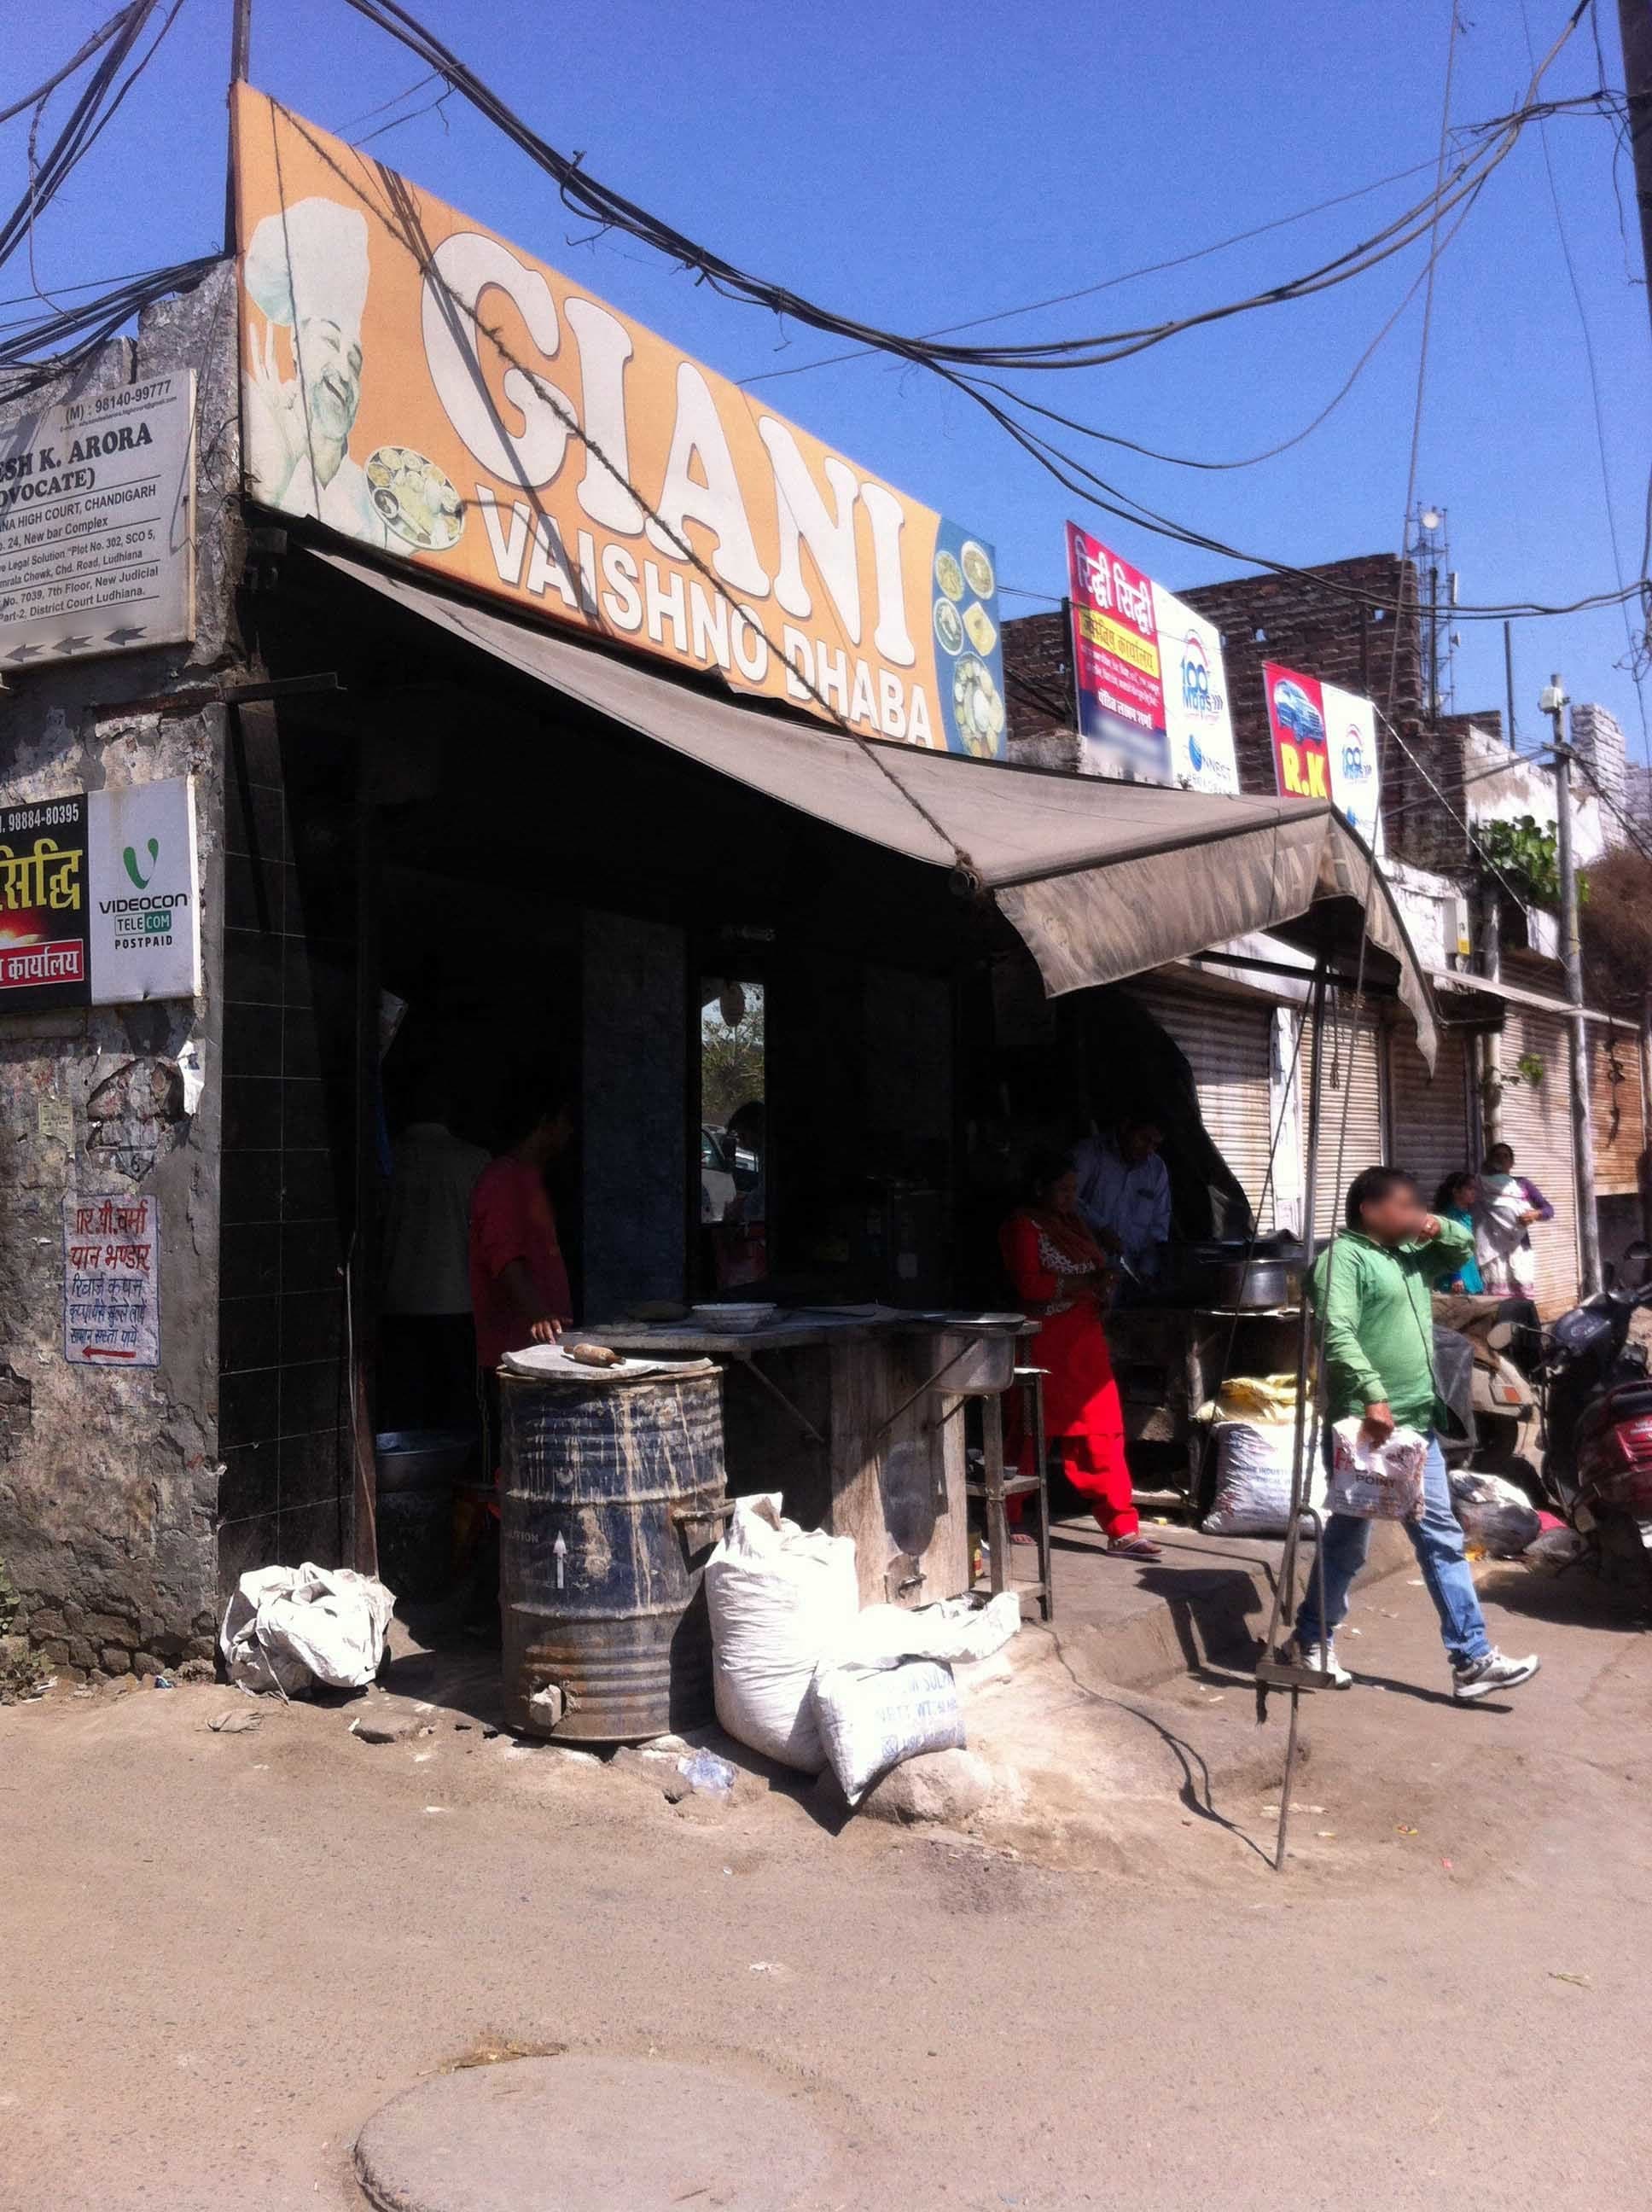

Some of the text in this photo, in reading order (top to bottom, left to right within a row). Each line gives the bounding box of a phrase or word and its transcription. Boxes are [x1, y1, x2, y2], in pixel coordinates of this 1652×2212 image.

[66, 405, 84, 425] (M)
[96, 379, 172, 413] 98140-99777
[39, 447, 61, 472] K.
[68, 422, 153, 464] ARORA
[422, 232, 915, 665] GIANI
[18, 511, 43, 528] HIGH
[45, 502, 83, 521] COURT,
[85, 484, 156, 512] CHANDIGARH
[8, 536, 22, 549] 24,
[24, 530, 44, 544] New
[47, 526, 62, 539] bar
[65, 515, 108, 535] Complex
[9, 556, 30, 572] Legal
[32, 550, 66, 566] Solution
[90, 540, 104, 552] No.
[107, 536, 124, 549] 302,
[125, 532, 146, 545] SCO
[148, 529, 156, 541] 5,
[24, 568, 54, 583] Chowk,
[55, 563, 74, 575] Chd.
[77, 557, 101, 571] Road,
[103, 549, 143, 566] Ludhiana
[3, 566, 159, 608] No. 7039, 7th Floor, New Judicial
[30, 601, 64, 616] District
[67, 596, 94, 609] Court
[96, 585, 146, 600] Ludhiana.
[475, 484, 935, 748] VAISHNO DHABA
[9, 803, 79, 832] 98884-80395
[99, 894, 188, 914] VIDEOCON
[115, 935, 172, 950] POSTPAID
[8, 946, 80, 981] कार्यालय
[71, 1243, 152, 1272] पान भण्डार
[1355, 1473, 1395, 1488] POINT
